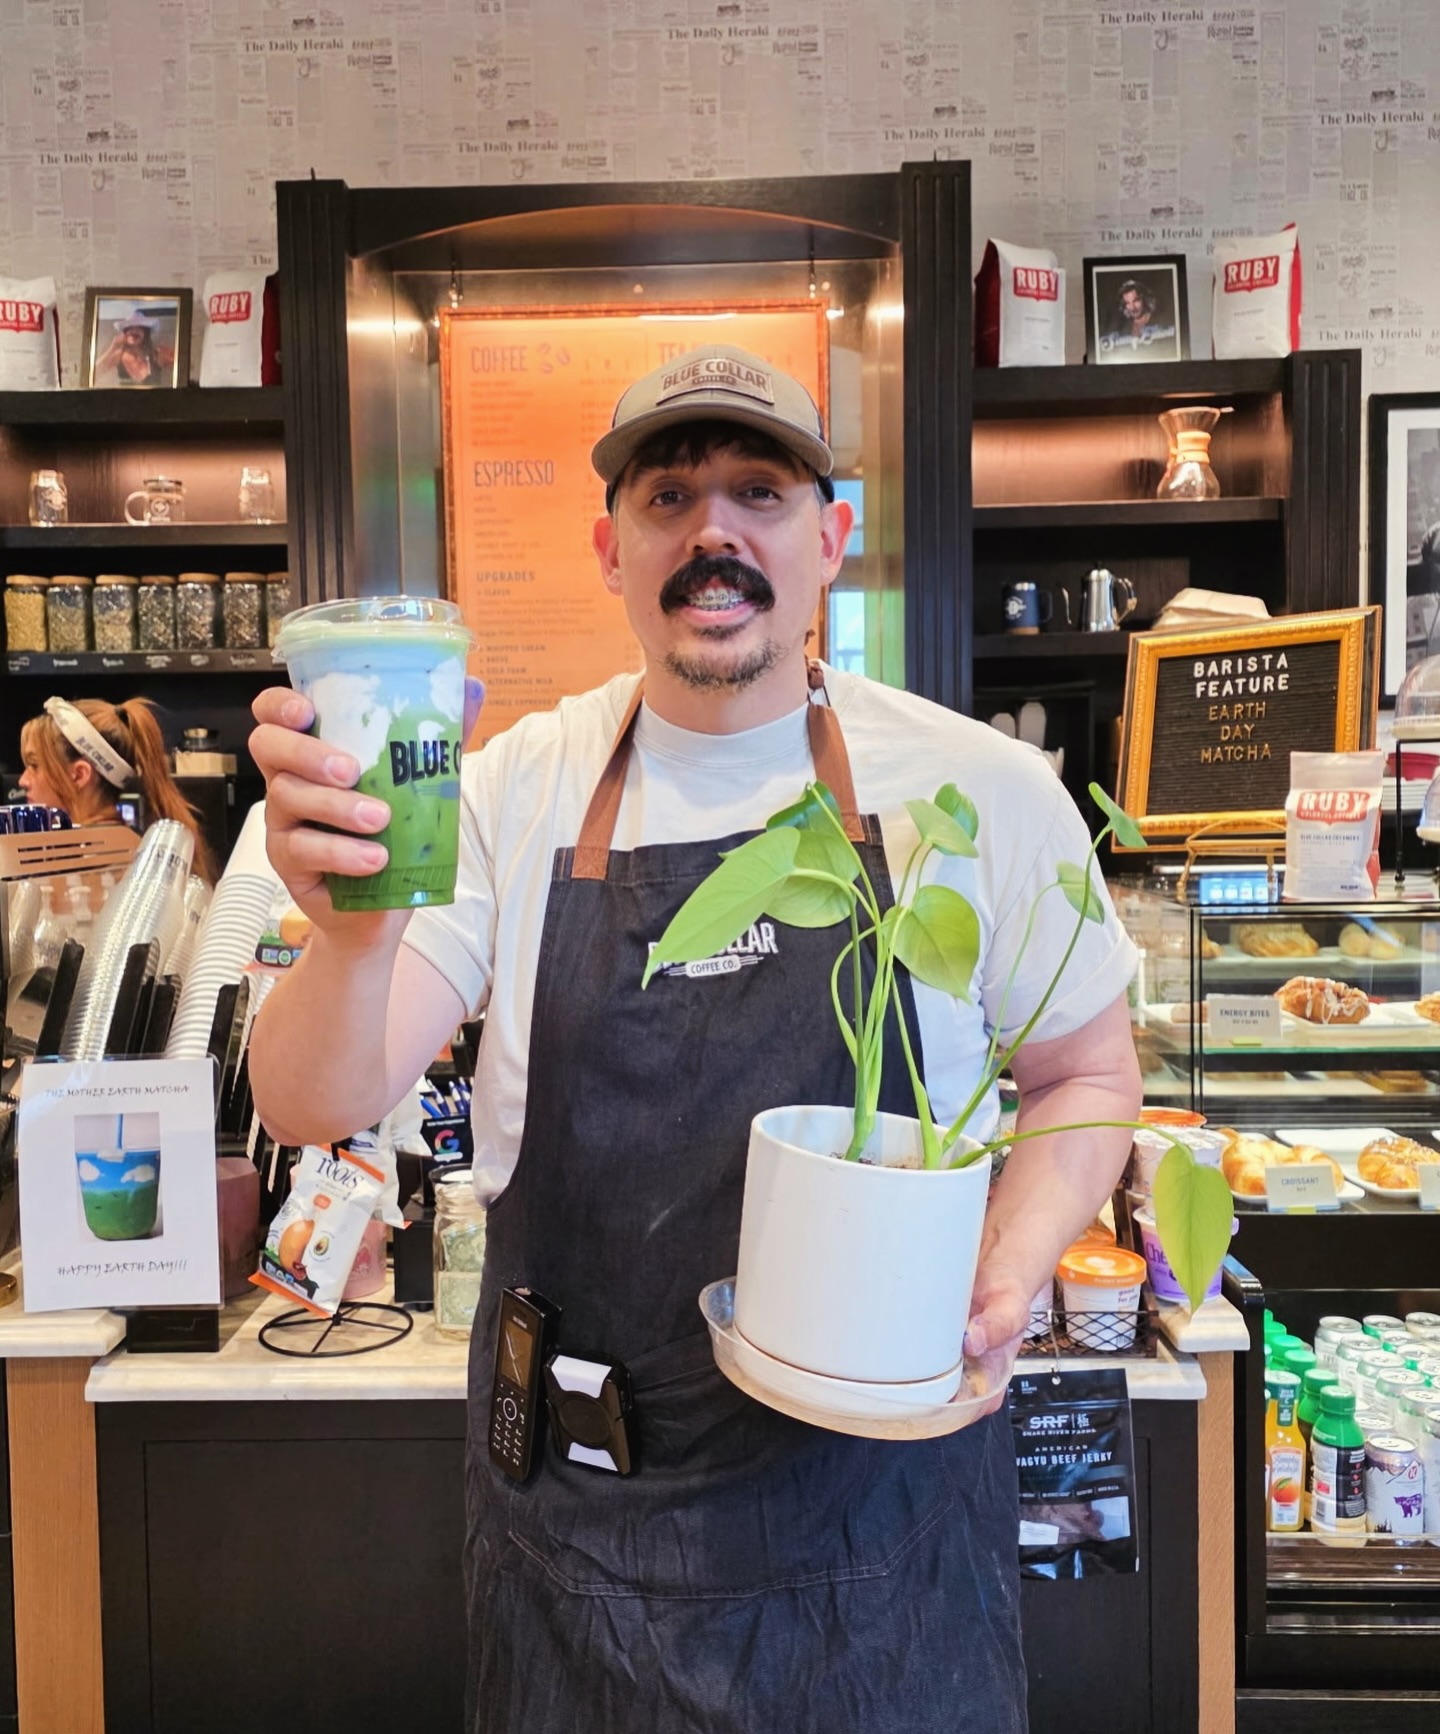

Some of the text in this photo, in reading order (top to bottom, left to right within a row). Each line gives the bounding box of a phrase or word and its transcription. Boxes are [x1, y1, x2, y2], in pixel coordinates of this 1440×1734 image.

[1099, 10, 1204, 26] The Daily Herald
[667, 25, 769, 40] The Daily Herald
[245, 38, 344, 53] The Daily Herald
[1318, 111, 1424, 126] The Daily Herald
[883, 127, 985, 141] The Daily Herald
[458, 140, 558, 154] The Daily Herald
[39, 151, 138, 165] The Daily Herald
[1100, 226, 1203, 242] The Daily Herald
[252, 254, 272, 266] The
[1228, 257, 1277, 282] RUBY
[1017, 269, 1057, 292] RUBY
[210, 292, 250, 315] RUBY
[1319, 327, 1421, 342] The Daily Herald
[471, 345, 528, 374] COFFEE
[662, 360, 768, 393] BLUE COLLAR
[474, 459, 555, 487] ESPRESSO
[477, 571, 536, 583] UPGRADES
[1193, 652, 1289, 678] BARISTA
[1196, 674, 1290, 699] FEATURE
[1208, 701, 1267, 721] EARTH
[1220, 724, 1255, 742] DAY
[1200, 744, 1272, 764] MATCHA
[389, 740, 450, 788] BLUE
[1302, 791, 1367, 813] RUBY
[690, 961, 738, 975] COFFEE CO.
[1220, 1009, 1270, 1017] ENERGY BITES
[46, 1084, 190, 1098] THE MOTHER EARTH MATCHA
[316, 1157, 365, 1190] roots
[1281, 1176, 1319, 1186] CROISSANT
[57, 1263, 101, 1277] HAPPY
[104, 1261, 145, 1274] EARTH
[1029, 1414, 1070, 1430] SRF
[1035, 1444, 1088, 1453] AMERICAN
[1051, 1454, 1077, 1465] BEEF
[1082, 1451, 1113, 1464] JERKY
